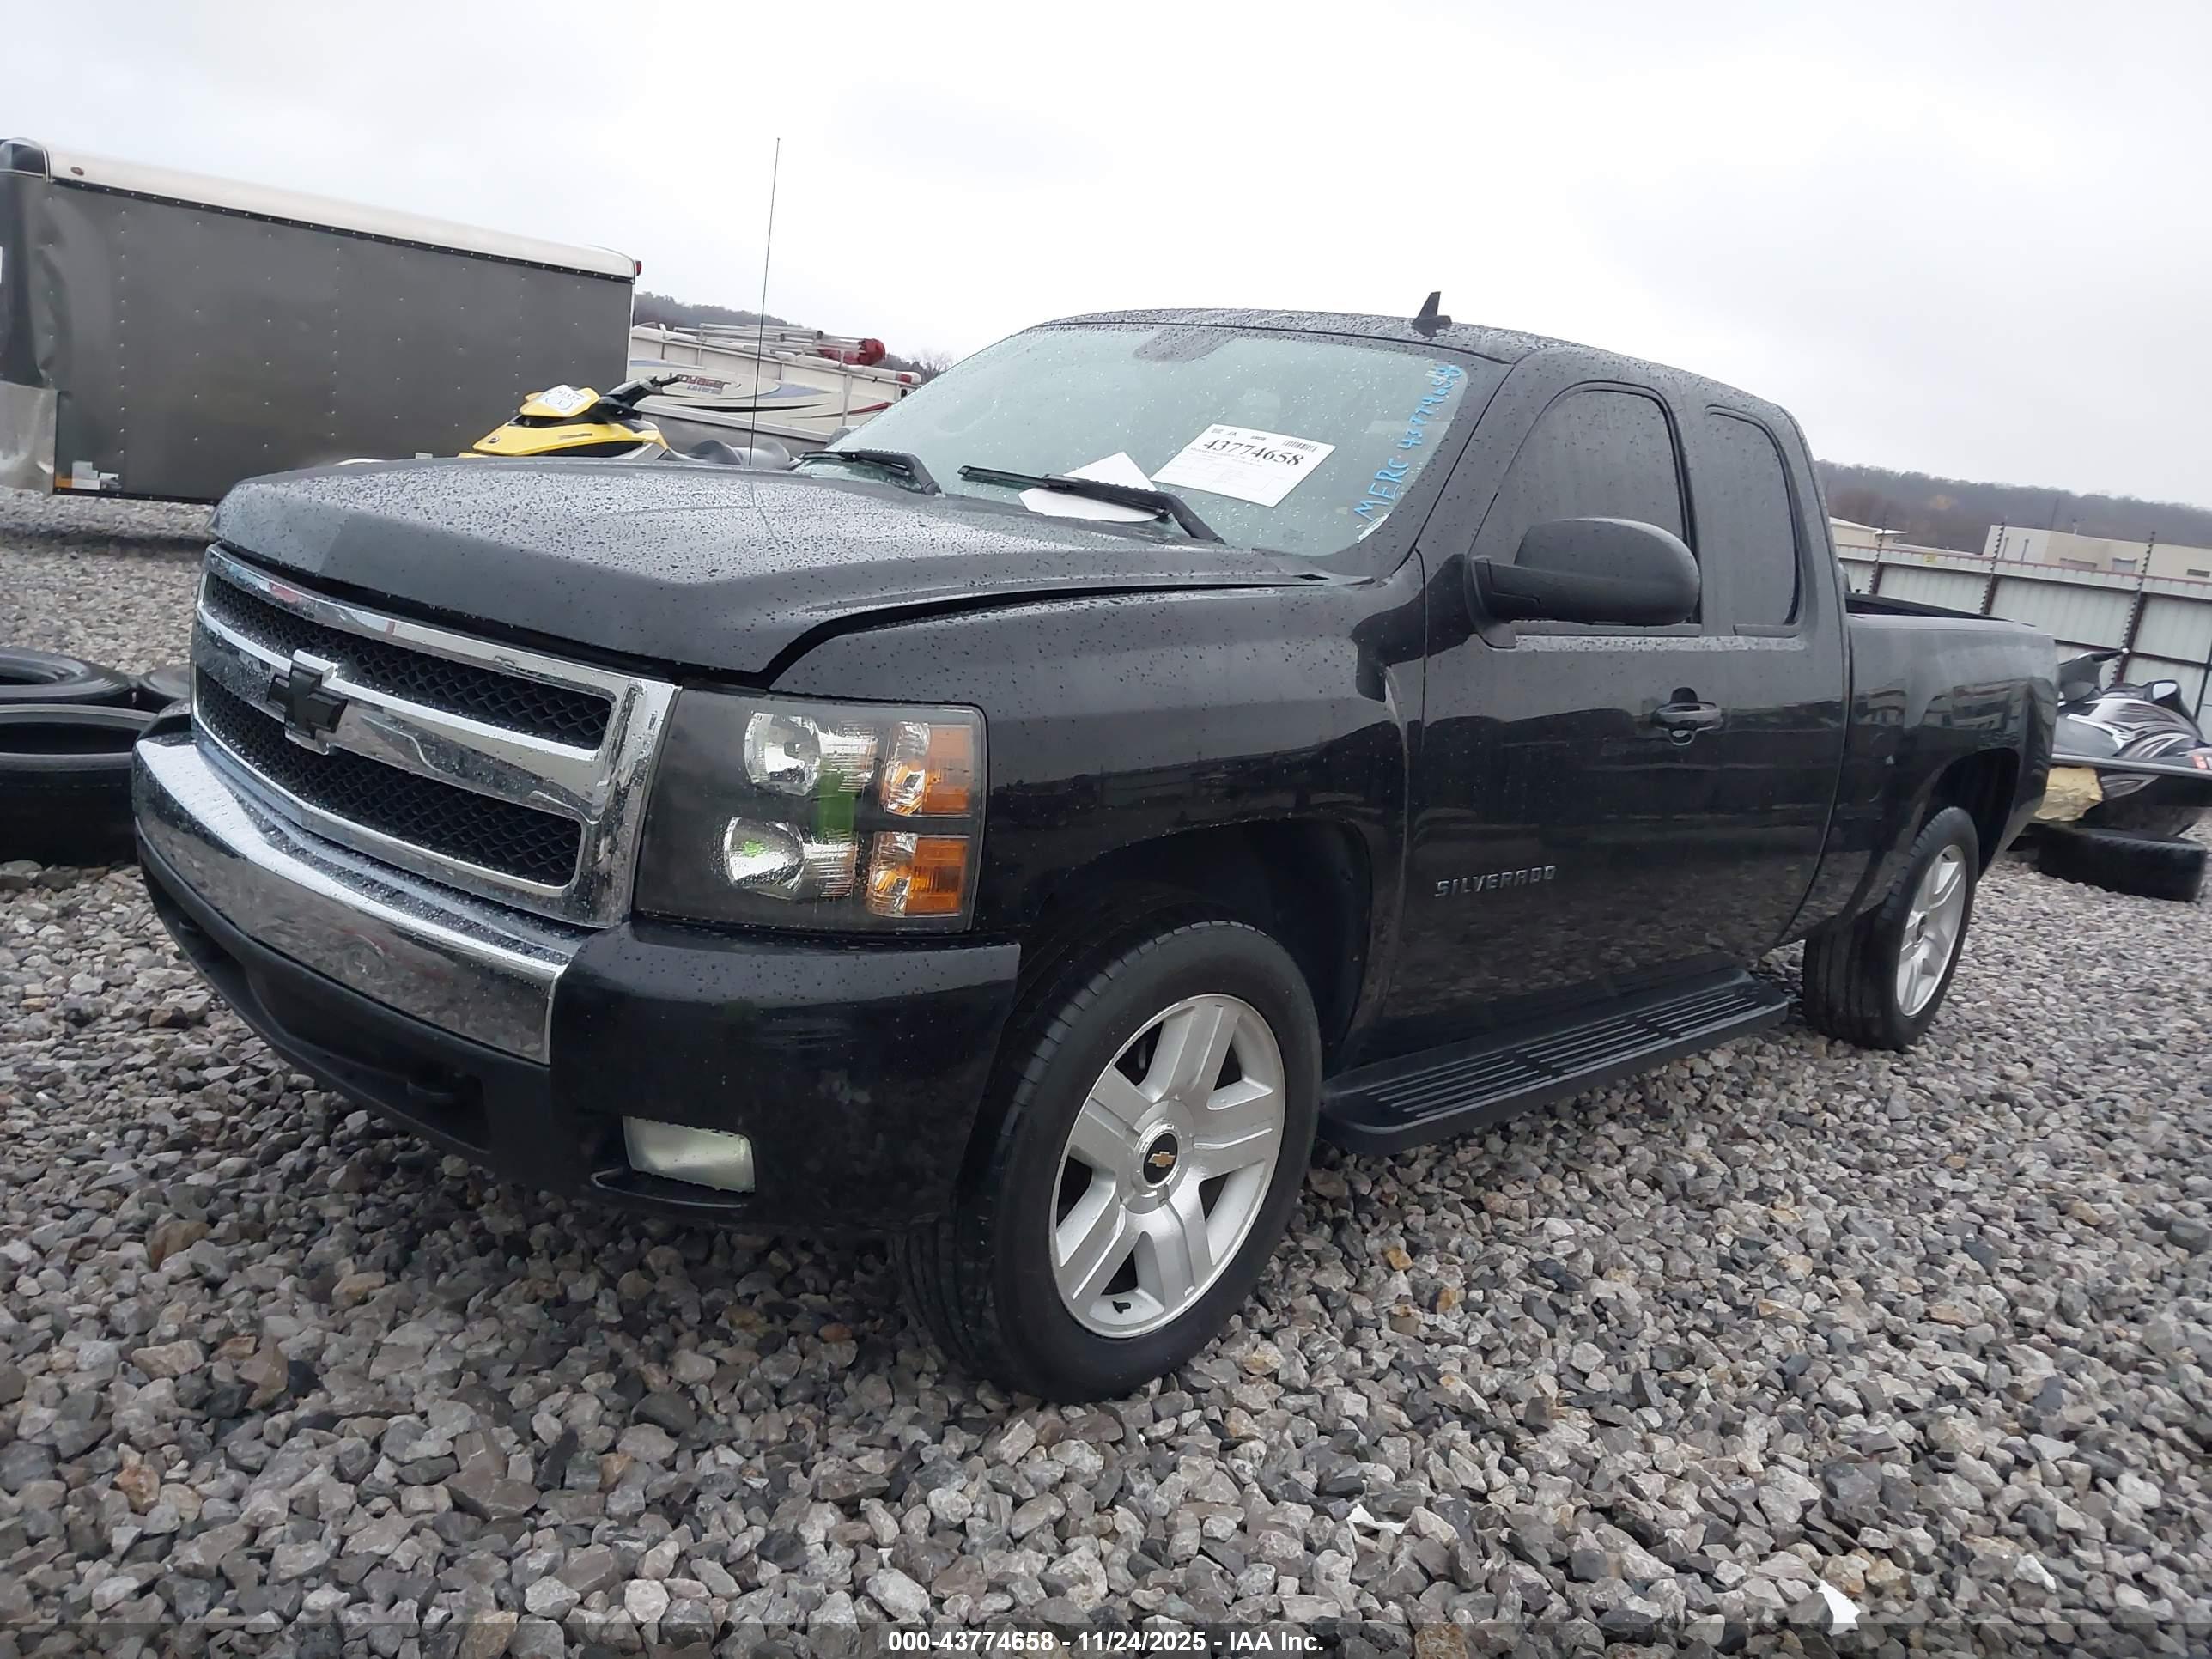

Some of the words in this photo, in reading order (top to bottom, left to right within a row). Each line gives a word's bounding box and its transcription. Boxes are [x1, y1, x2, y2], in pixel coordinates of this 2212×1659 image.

[1203, 438, 1304, 466] 43774658
[1353, 458, 1409, 521] MERC
[1434, 865, 1557, 897] SILVERADO
